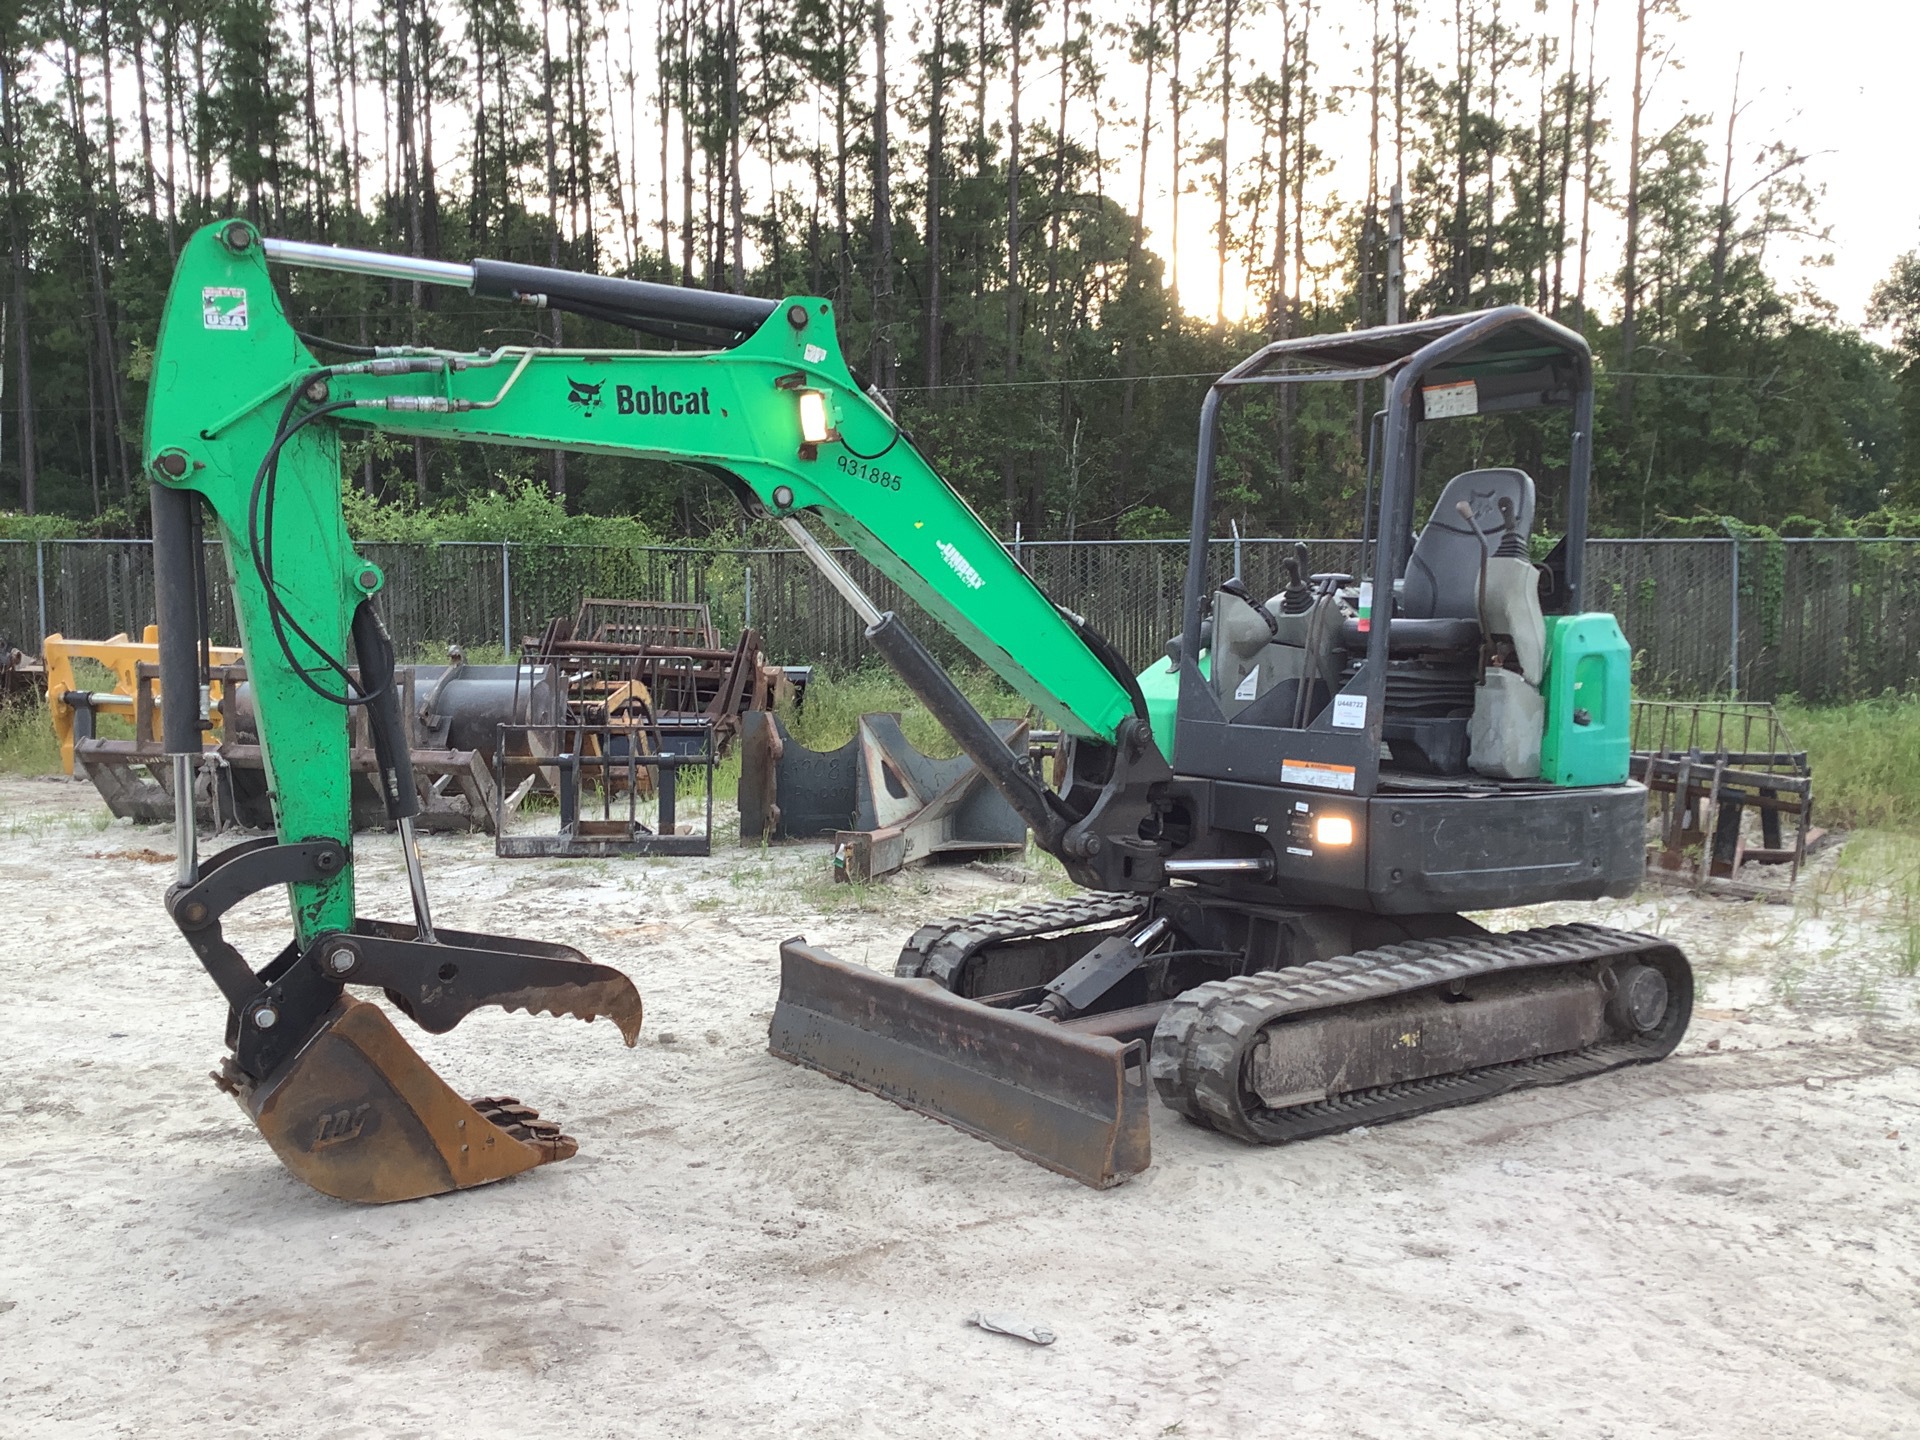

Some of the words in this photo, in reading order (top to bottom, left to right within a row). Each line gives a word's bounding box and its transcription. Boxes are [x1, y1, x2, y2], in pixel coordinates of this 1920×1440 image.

[205, 314, 246, 326] USA
[616, 384, 711, 415] Bobcat
[838, 456, 902, 491] 931885
